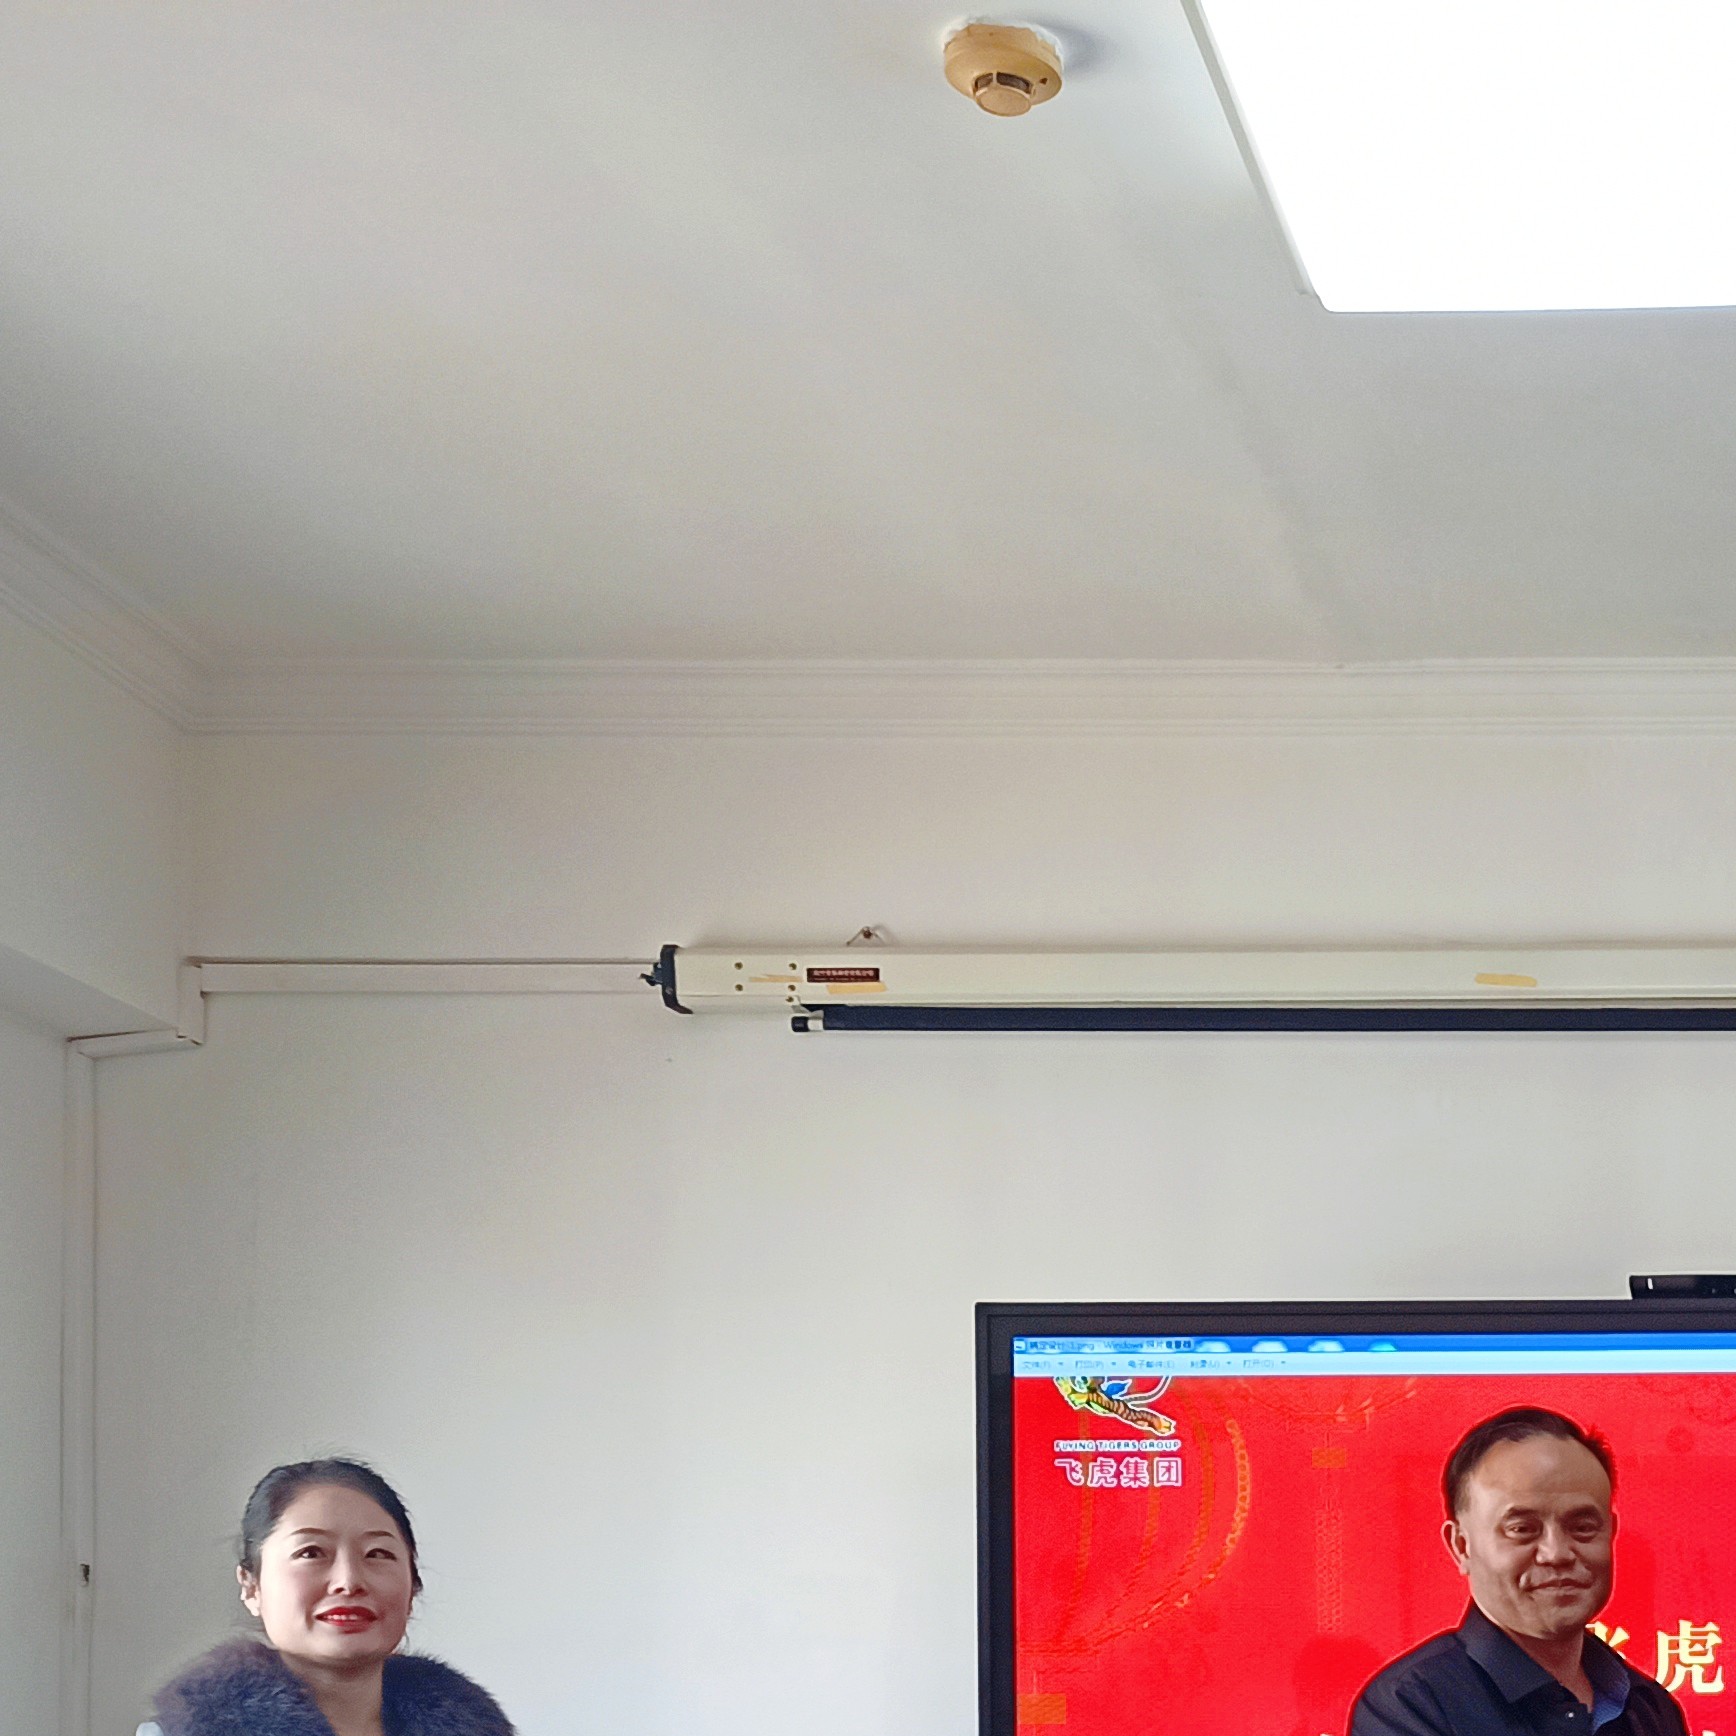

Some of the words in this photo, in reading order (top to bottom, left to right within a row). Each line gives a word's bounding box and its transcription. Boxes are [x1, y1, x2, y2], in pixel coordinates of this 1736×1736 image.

[1097, 1440, 1138, 1451] TIGERS
[1140, 1440, 1181, 1451] GROUP
[1054, 1457, 1182, 1488] 飞虎集团
